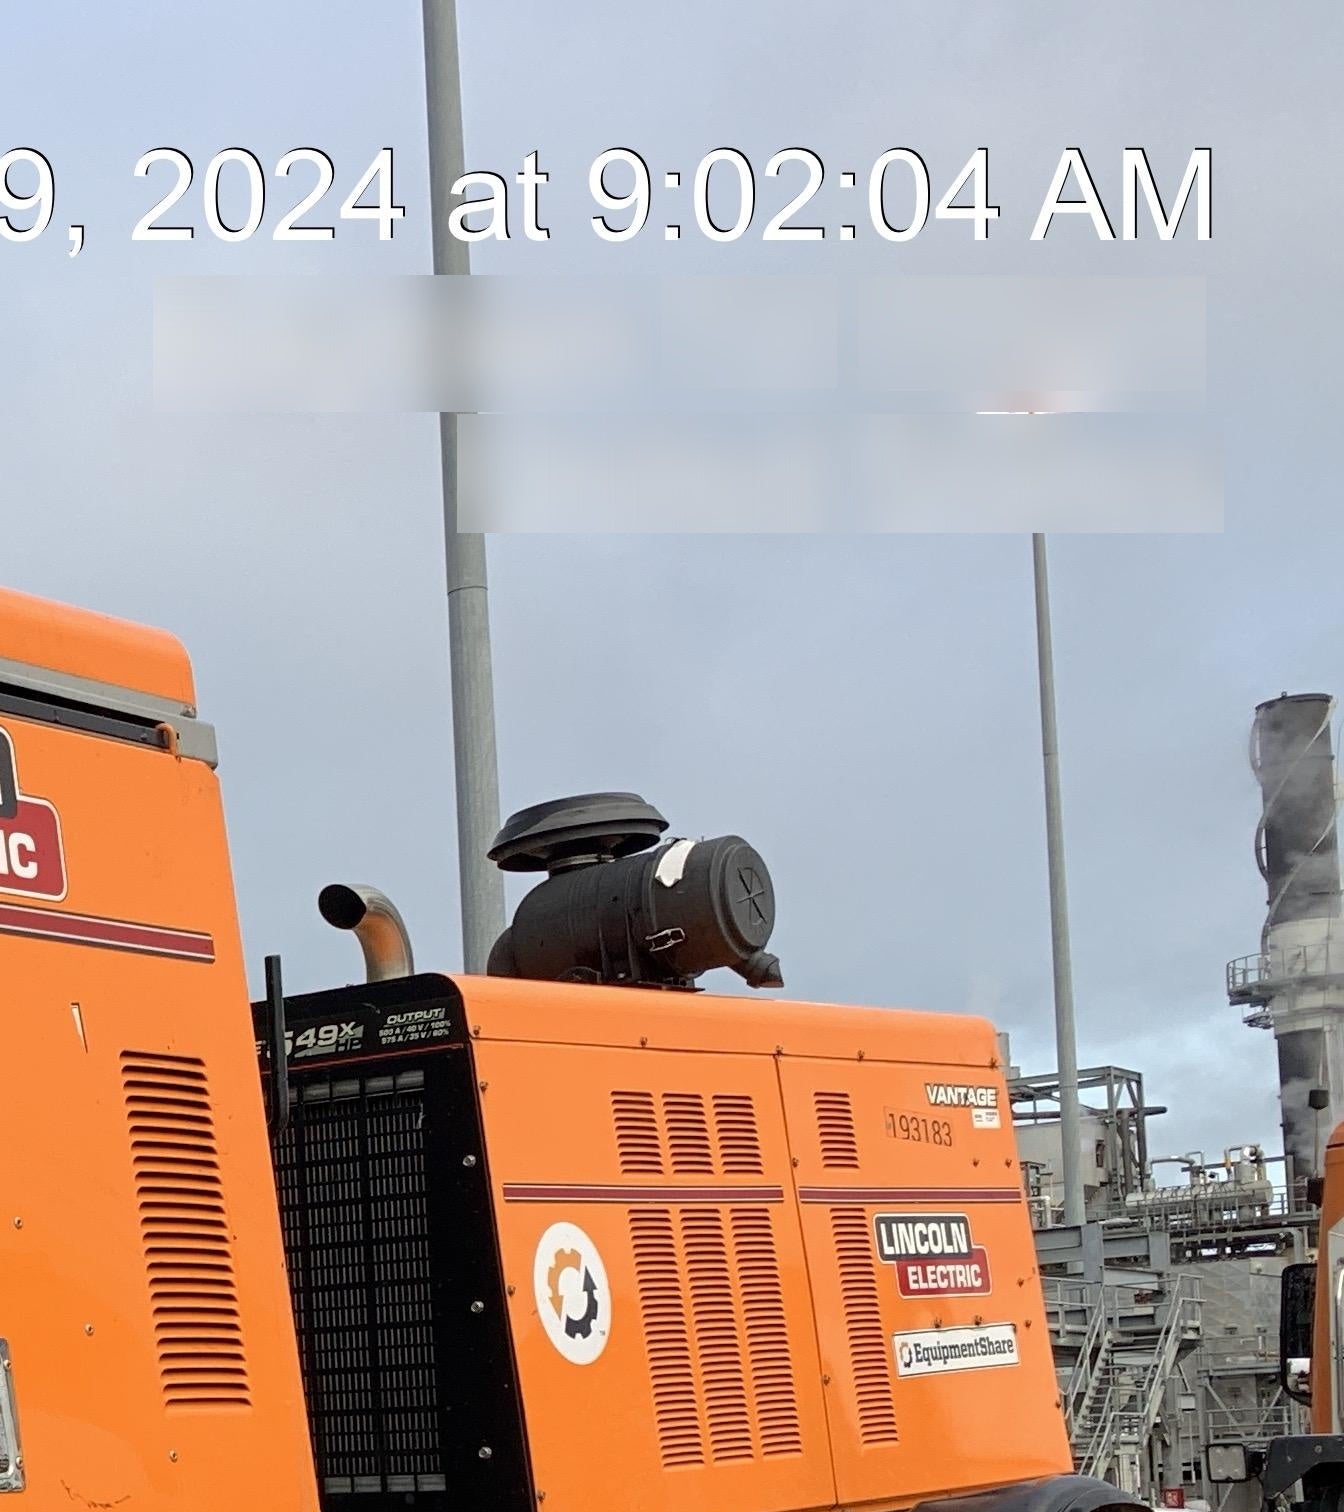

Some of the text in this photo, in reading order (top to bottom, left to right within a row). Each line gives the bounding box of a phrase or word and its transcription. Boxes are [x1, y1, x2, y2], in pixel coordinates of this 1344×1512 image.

[386, 1007, 443, 1025] OUTPUT
[925, 1084, 997, 1107] VANTAGE
[888, 1113, 953, 1147] 193183
[879, 1221, 969, 1255] LINCOLN
[906, 1263, 982, 1290] ELECTRIC
[913, 1333, 1015, 1367] EquipmentShare
